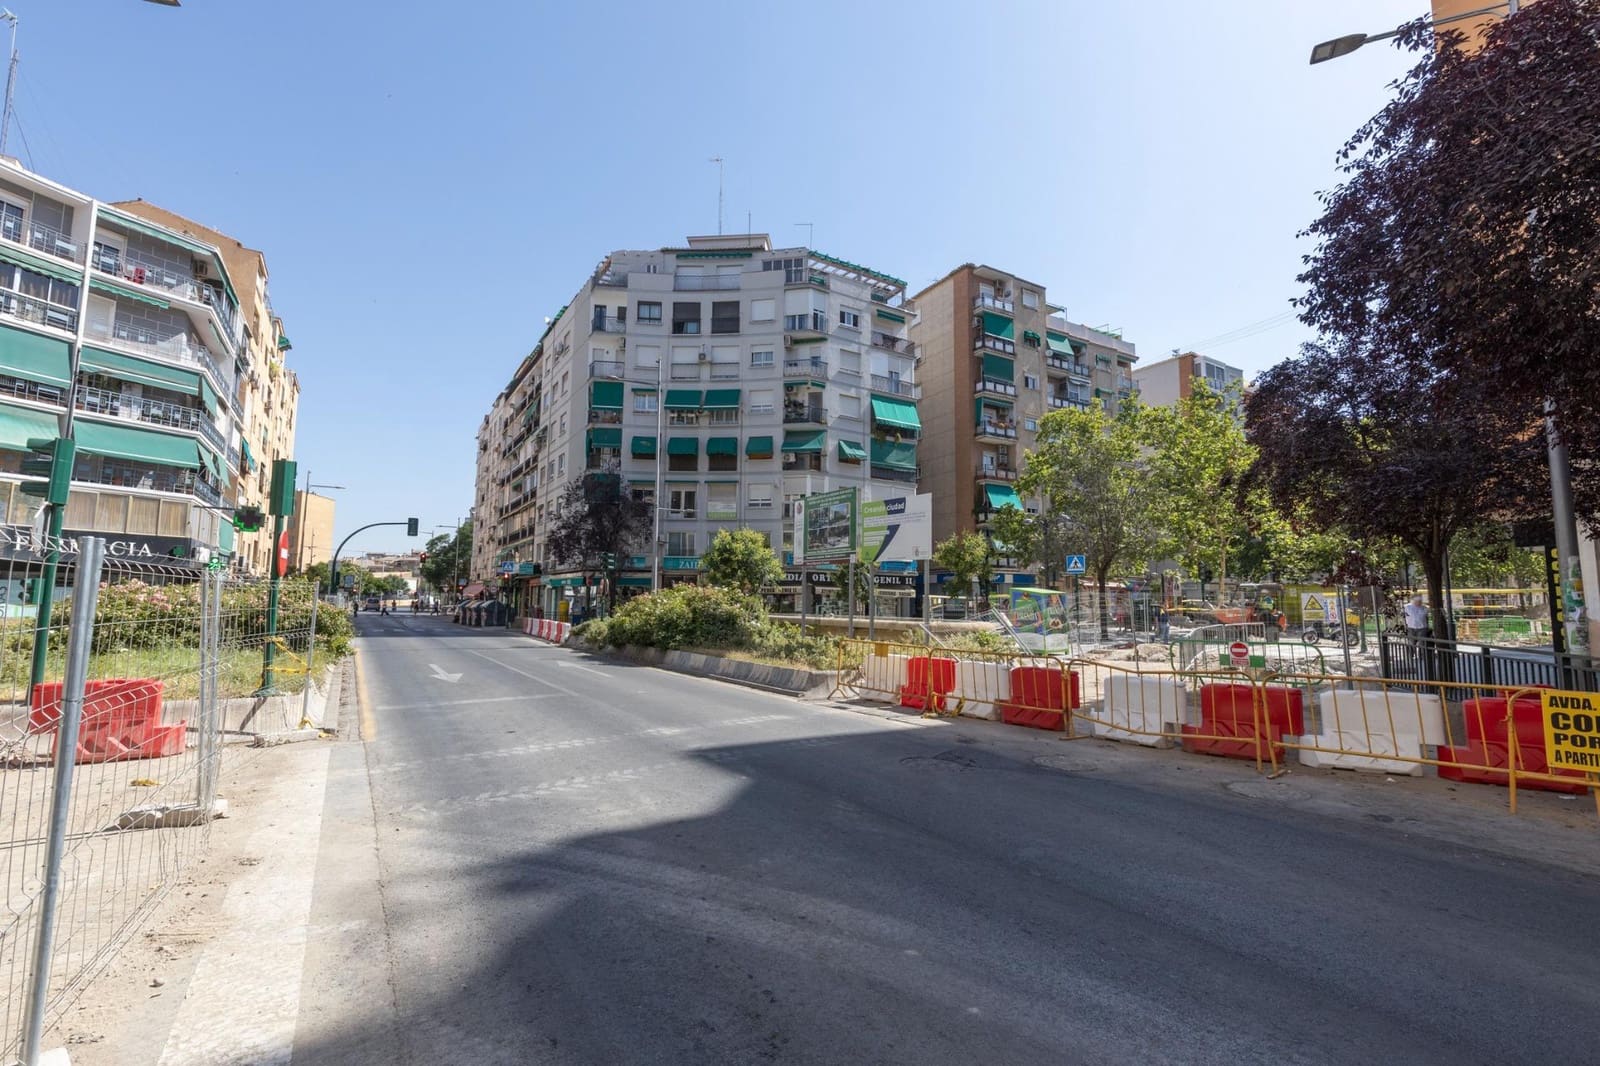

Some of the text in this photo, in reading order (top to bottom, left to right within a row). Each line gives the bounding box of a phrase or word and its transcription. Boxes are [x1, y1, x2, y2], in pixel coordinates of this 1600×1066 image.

[886, 502, 905, 511] ciudad
[14, 534, 153, 557] FRMCIA
[874, 576, 901, 585] GENIL
[1549, 695, 1597, 711] AVDA.
[1555, 749, 1600, 768] A PARTI
